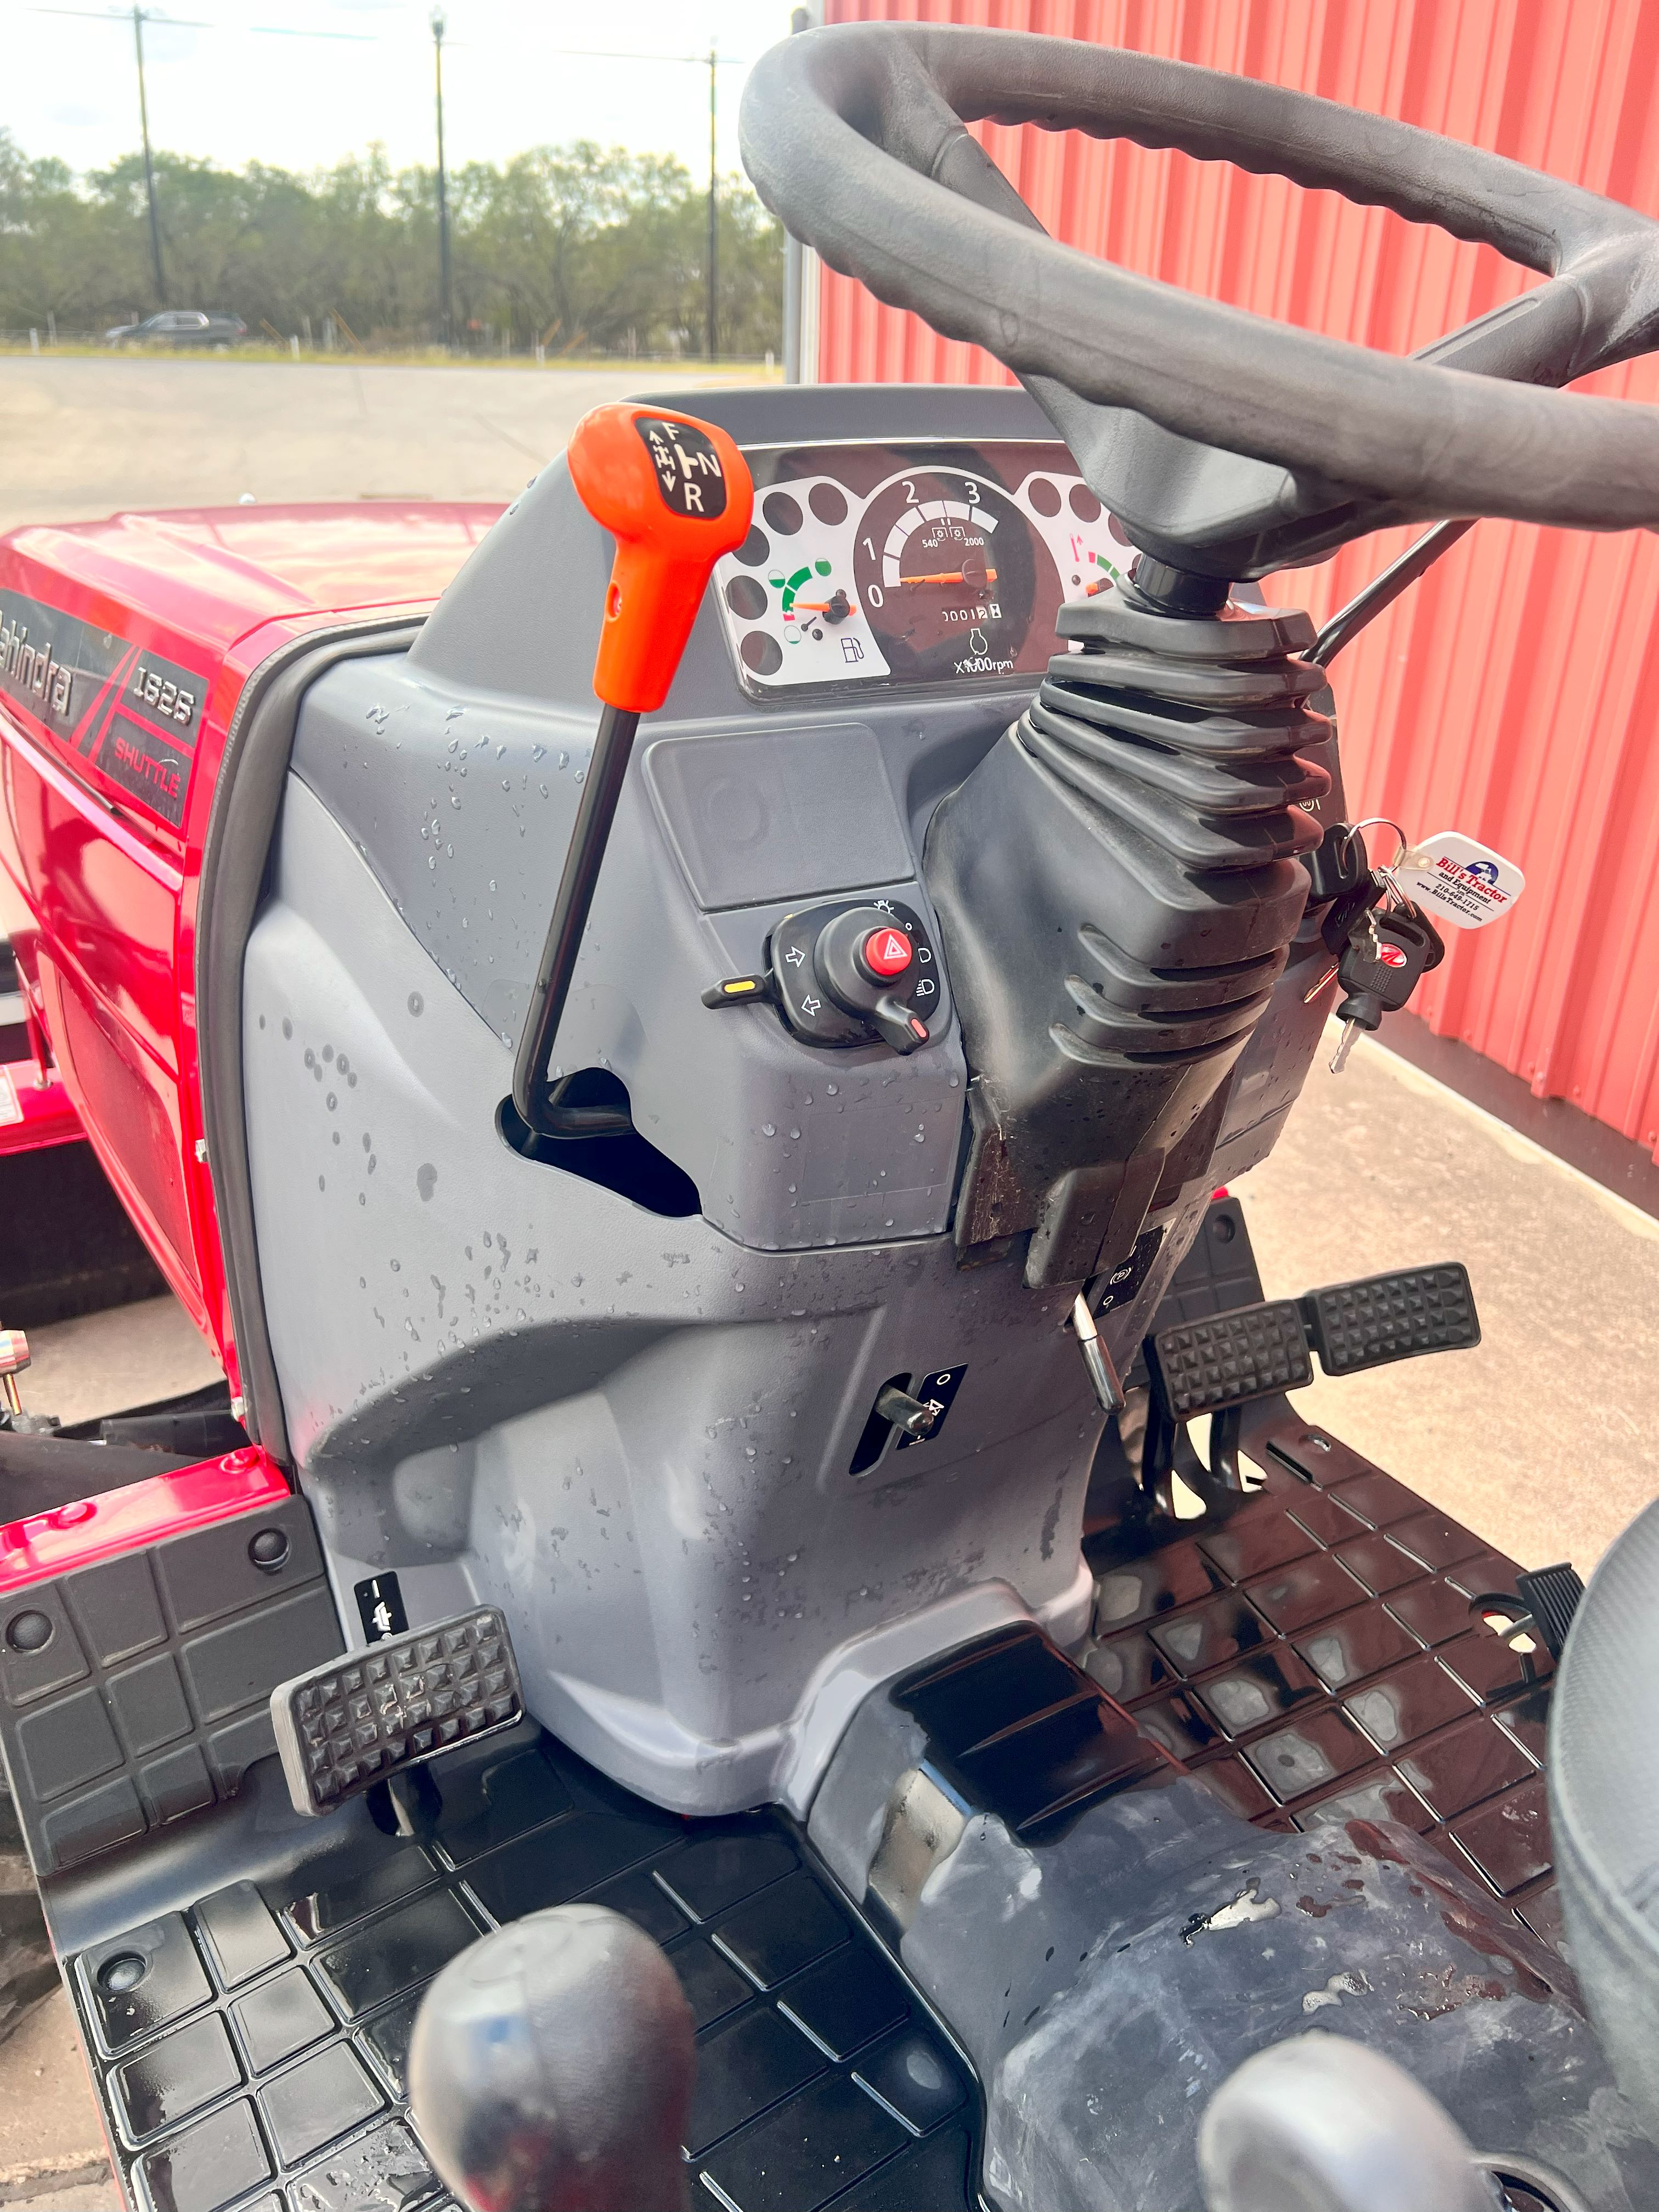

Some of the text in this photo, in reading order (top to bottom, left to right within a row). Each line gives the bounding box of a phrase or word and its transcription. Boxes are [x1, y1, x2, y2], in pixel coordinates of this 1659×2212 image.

[662, 422, 679, 441] F
[696, 452, 722, 477] N
[684, 482, 704, 512] R
[902, 481, 919, 504] 2
[964, 482, 981, 504] 3
[862, 538, 876, 561] 1
[922, 539, 938, 548] 540
[964, 537, 984, 546] 2000
[867, 584, 884, 608] 0
[0, 610, 72, 715] ahindra
[133, 667, 195, 724] 1626
[114, 738, 181, 798] SHUTTLE
[1436, 857, 1508, 903] Bill's Tractor
[1438, 871, 1491, 904] and Equipment
[1435, 883, 1480, 911] 210-649-1715
